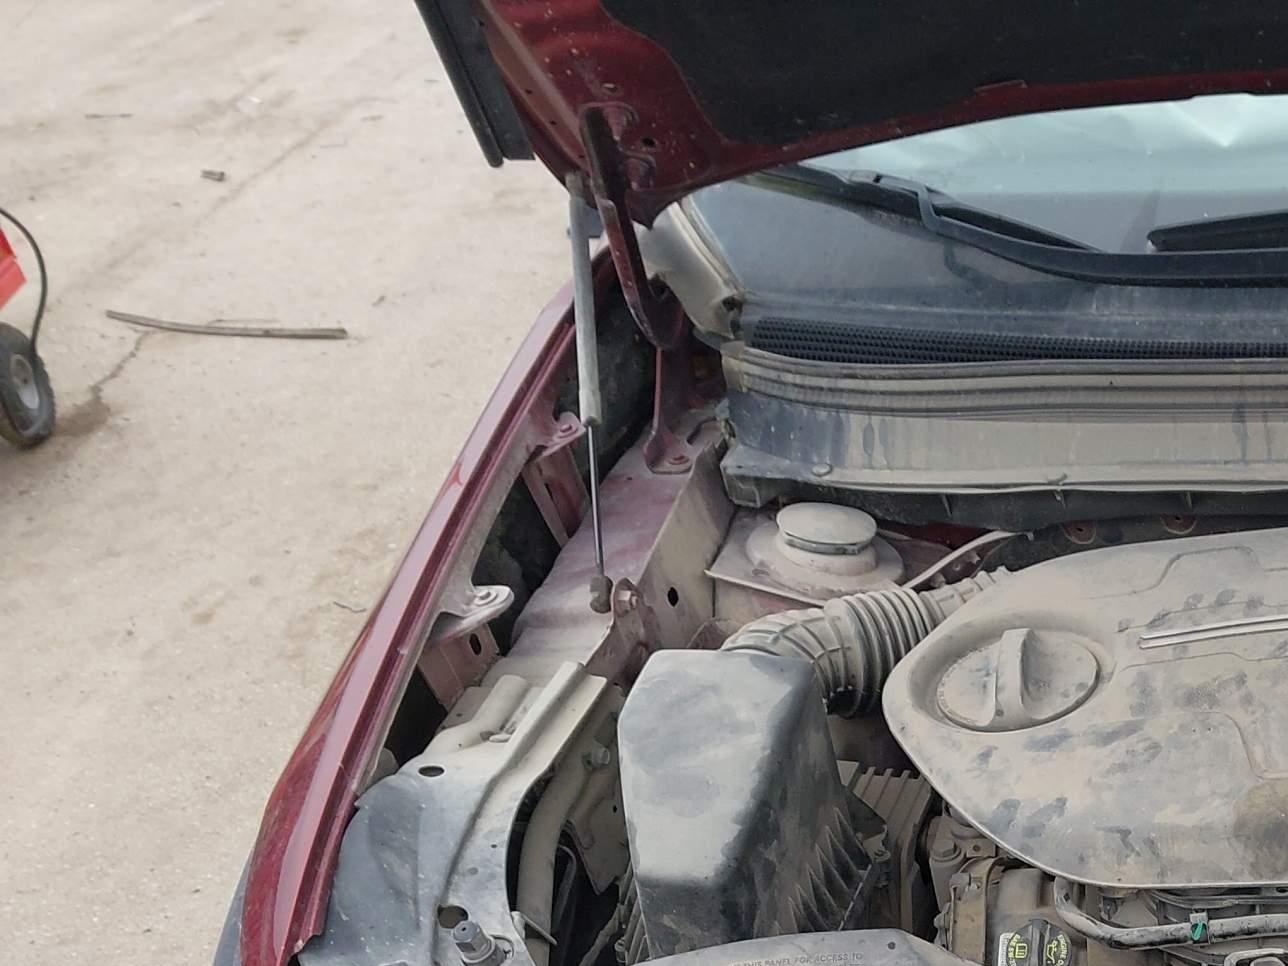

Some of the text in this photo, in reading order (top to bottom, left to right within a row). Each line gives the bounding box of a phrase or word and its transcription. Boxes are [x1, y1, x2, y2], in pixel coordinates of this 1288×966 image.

[1057, 934, 1067, 959] ENGINE
[765, 958, 790, 966] PANEL
[793, 956, 811, 965] FOR
[814, 953, 849, 962] ACCESS
[852, 952, 864, 960] TO
